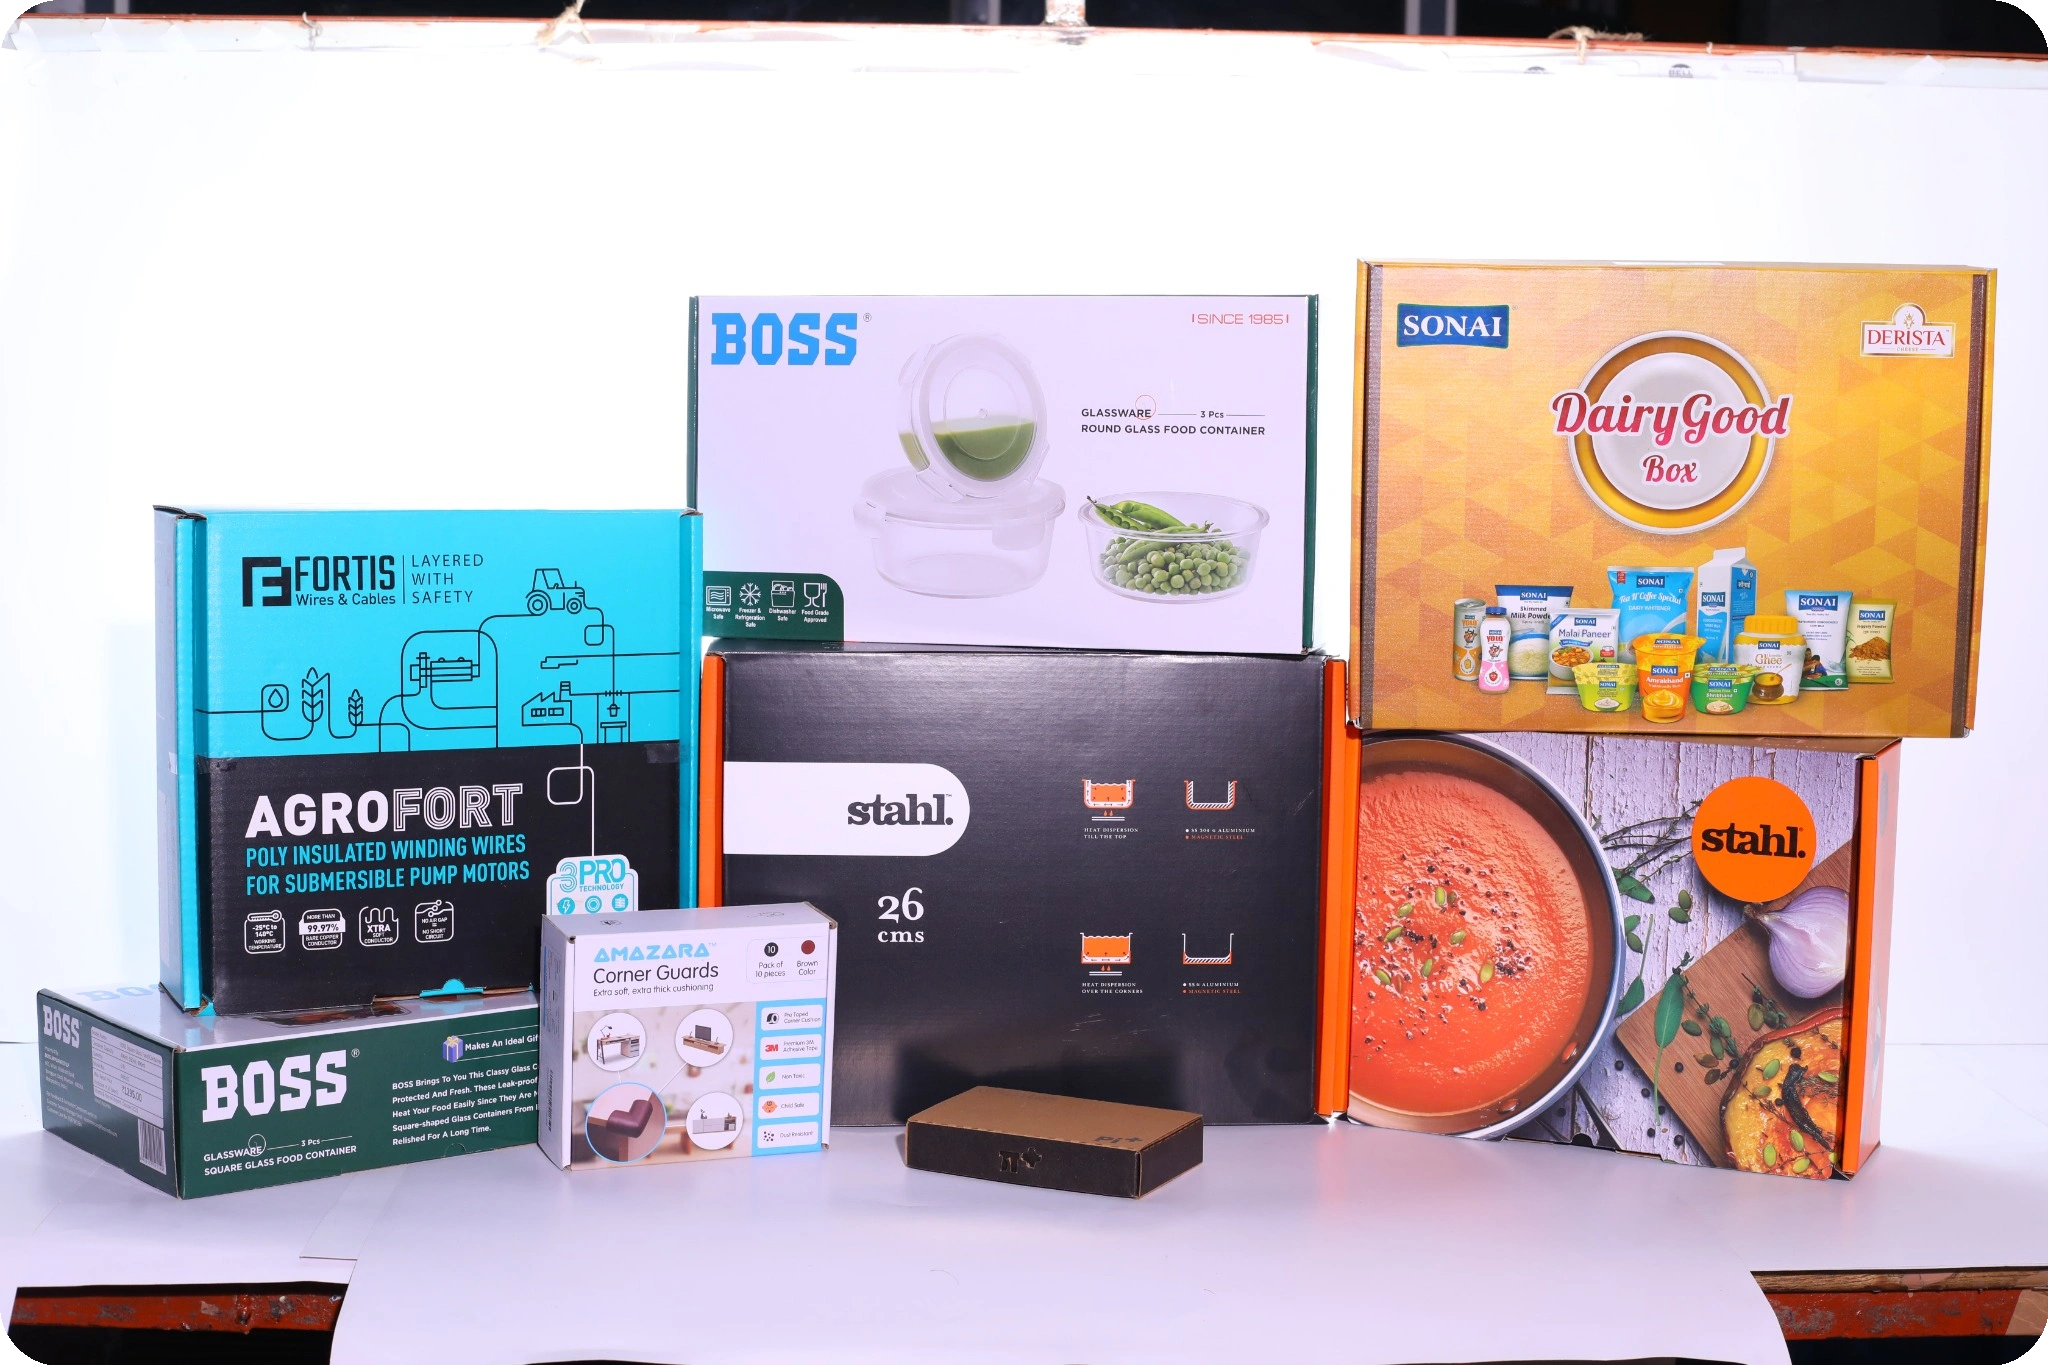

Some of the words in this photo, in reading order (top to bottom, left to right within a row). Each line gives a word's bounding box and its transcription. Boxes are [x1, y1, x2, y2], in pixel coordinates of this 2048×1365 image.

[1197, 313, 1243, 324] SINCE
[1249, 314, 1283, 324] 1985
[1403, 315, 1502, 337] SONAI
[711, 313, 857, 365] BOSS
[1867, 329, 1946, 346] DERISTA
[1081, 408, 1151, 418] GLASSWARE
[1200, 410, 1205, 418] 3
[1209, 410, 1224, 418] Pcs
[1081, 424, 1121, 433] ROUND
[1125, 424, 1160, 434] GLASS
[1164, 425, 1196, 434] FOOD
[1200, 425, 1265, 435] CONTAINER
[1642, 454, 1698, 483] Box
[411, 554, 484, 567] LAYERED
[295, 555, 395, 591] FORTIS
[411, 573, 454, 586] WITH
[1637, 578, 1664, 586] SONAI
[296, 594, 334, 606] Wires
[338, 594, 348, 605] &
[352, 593, 396, 605] Cables
[412, 590, 473, 604] SAFETY
[1640, 592, 1658, 602] Coffee
[1702, 594, 1725, 603] SONAI
[1800, 597, 1837, 607] SONAI
[1558, 629, 1580, 638] Malai
[1581, 630, 1611, 638] Paneer
[1755, 653, 1782, 665] Ghee
[245, 783, 523, 838] AGROFORT
[848, 794, 954, 825] stahl.
[1701, 823, 1806, 858] stahl.
[246, 846, 287, 867] POLY
[293, 841, 386, 865] INSULATED
[391, 837, 467, 860] WINDING
[472, 834, 526, 854] WIRES
[246, 875, 279, 895] FOR
[285, 868, 405, 893] SUBMERSIBLE
[410, 865, 458, 886] PUMP
[463, 861, 530, 883] MOTORS
[579, 884, 624, 892] TECHNOLOGY
[878, 887, 924, 924] 26
[307, 923, 339, 933] 99.97%
[367, 925, 391, 933] XTRA
[877, 931, 925, 943] cms
[594, 943, 709, 962] AMAZARA
[768, 946, 776, 954] 10
[593, 967, 651, 984] Corner
[657, 962, 719, 981] Guards
[759, 961, 774, 969] Pack
[764, 970, 785, 978] pieces
[593, 988, 612, 997] Extra
[614, 987, 630, 996] soft,
[632, 986, 651, 995] extra
[653, 984, 671, 993] thick
[672, 983, 714, 993] cushioning
[43, 1004, 80, 1049] BOSS
[465, 1043, 490, 1051] Makes
[505, 1036, 525, 1046] Ideal
[526, 1034, 538, 1043] Gif
[765, 1044, 778, 1052] 3M
[201, 1049, 347, 1123] BOSS
[392, 1081, 413, 1090] BOSS
[415, 1078, 440, 1088] Brings
[442, 1075, 451, 1083] To
[469, 1071, 484, 1079] This
[486, 1068, 509, 1077] Classy
[511, 1065, 531, 1073] Glass
[392, 1093, 430, 1104] Protected
[431, 1089, 448, 1098] And
[449, 1087, 472, 1096] Fresh.
[474, 1084, 496, 1092] These
[412, 1107, 430, 1115] Your
[432, 1104, 452, 1112] Food
[453, 1100, 475, 1109] Easily
[477, 1097, 497, 1105] Since
[499, 1094, 517, 1102] They
[392, 1116, 450, 1132] Square-shaped
[451, 1114, 471, 1123] Glass
[473, 1108, 513, 1119] Containers
[514, 1105, 534, 1113] From
[392, 1136, 426, 1146] Relished
[427, 1133, 440, 1141] For
[450, 1127, 470, 1137] Long
[471, 1125, 492, 1134] Time.
[203, 1146, 263, 1162] GLASSWARE
[307, 1138, 321, 1146] Pcs
[204, 1162, 243, 1176] SQUARE
[245, 1158, 275, 1169] GLASS
[276, 1153, 303, 1165] FOOD
[305, 1145, 357, 1159] CONTAINER
